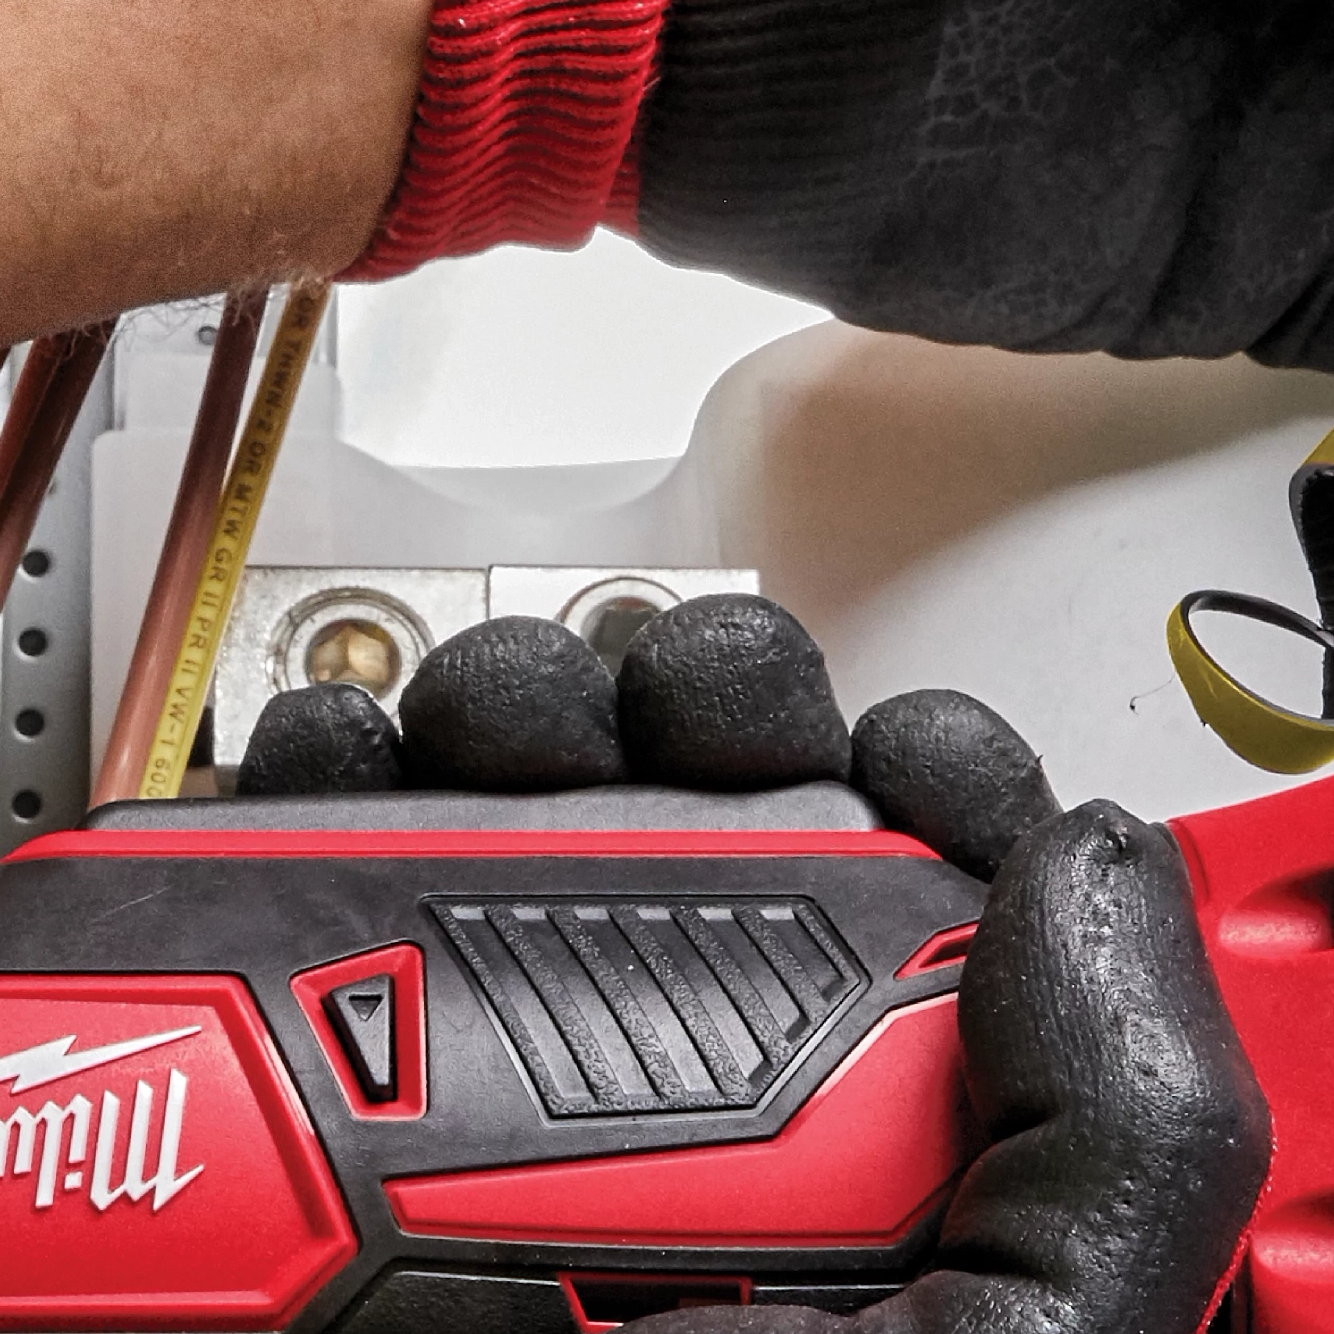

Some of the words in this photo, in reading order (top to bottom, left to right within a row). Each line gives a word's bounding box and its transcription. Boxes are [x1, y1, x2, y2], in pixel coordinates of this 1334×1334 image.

[296, 297, 315, 328] OR
[260, 341, 304, 431] THWN-2
[245, 442, 268, 475] OR
[223, 483, 254, 541] MTW
[209, 548, 232, 582] GR
[187, 617, 210, 649] PR
[159, 686, 192, 745] VW-1
[146, 758, 174, 798] 600
